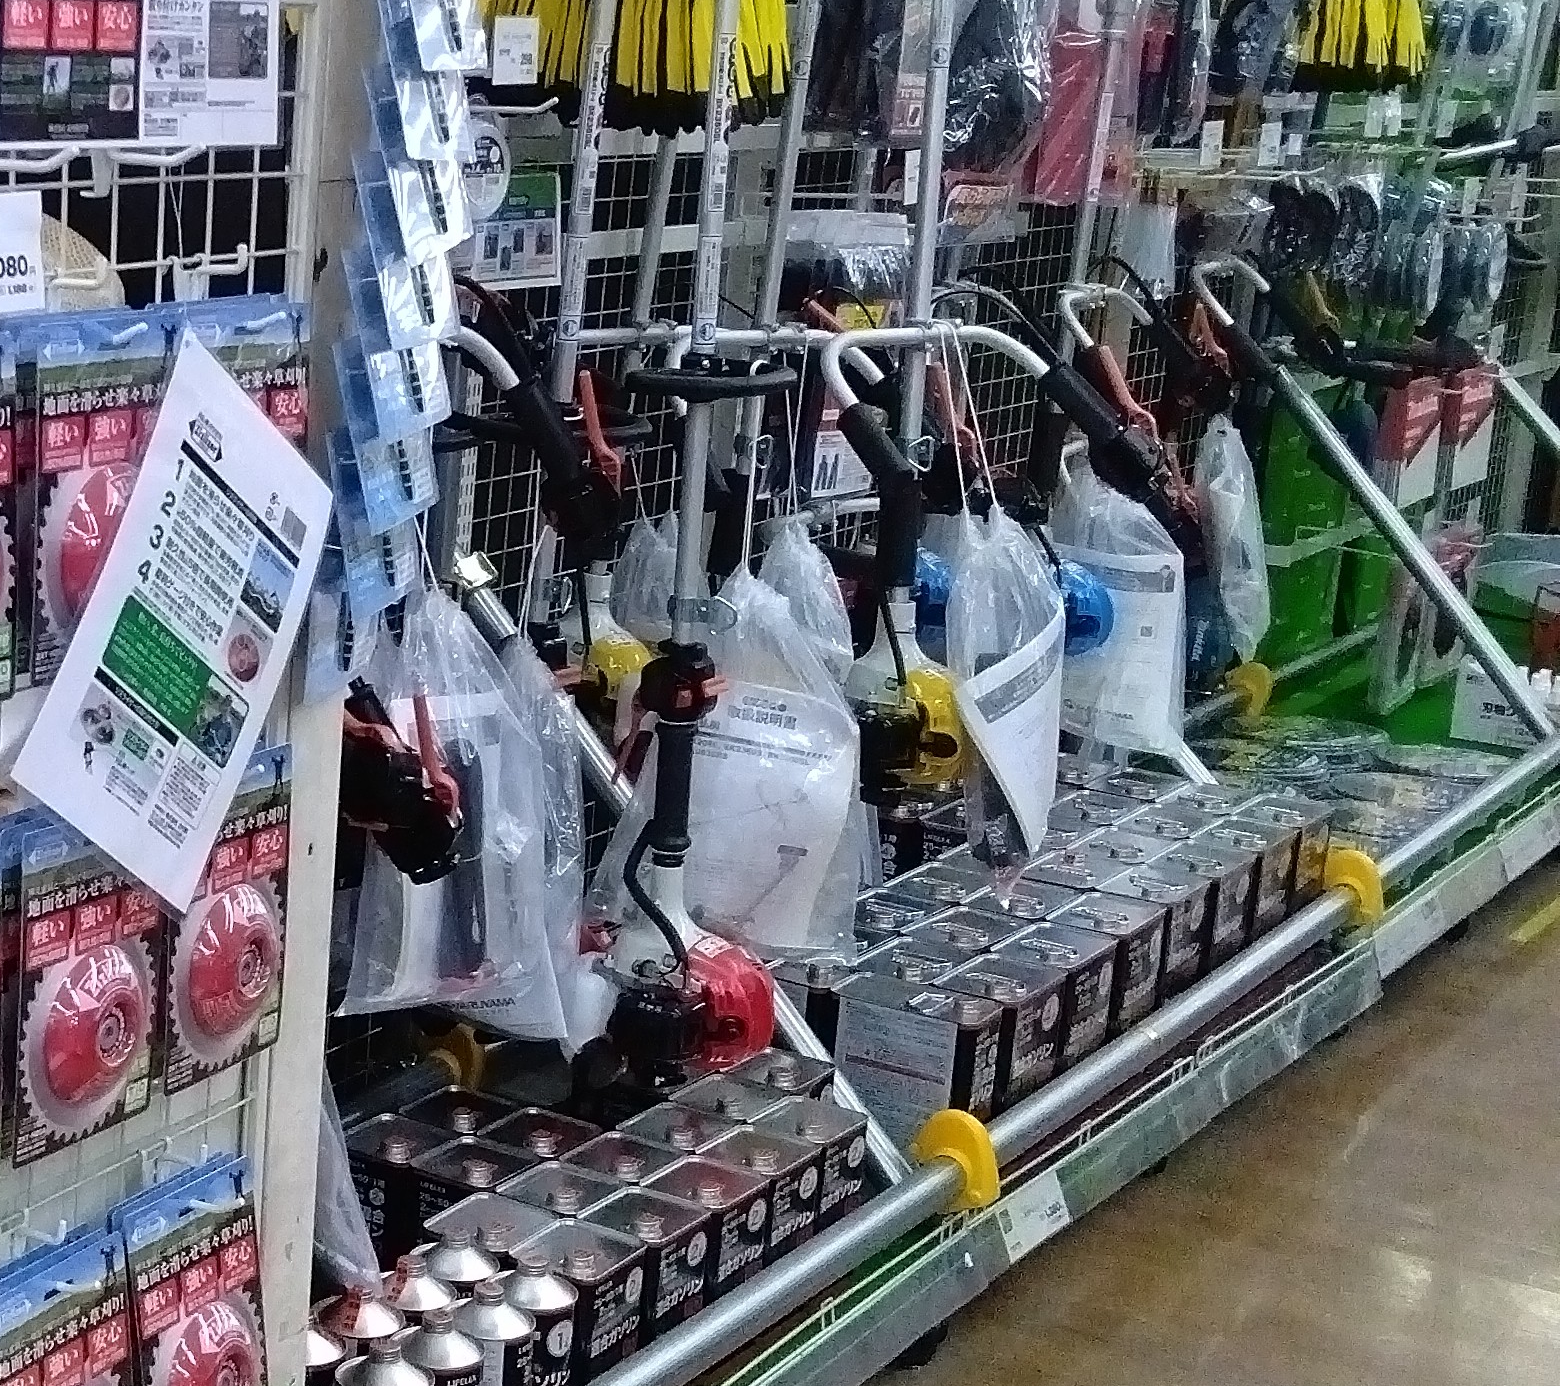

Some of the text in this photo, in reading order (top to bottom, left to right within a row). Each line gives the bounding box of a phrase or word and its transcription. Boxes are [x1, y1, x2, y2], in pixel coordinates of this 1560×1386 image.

[46, 423, 80, 447] 軽い
[160, 490, 176, 517] 2
[149, 524, 165, 550] 3
[138, 559, 152, 585] 4
[223, 1242, 253, 1270] 安心
[92, 1321, 124, 1354] 安心
